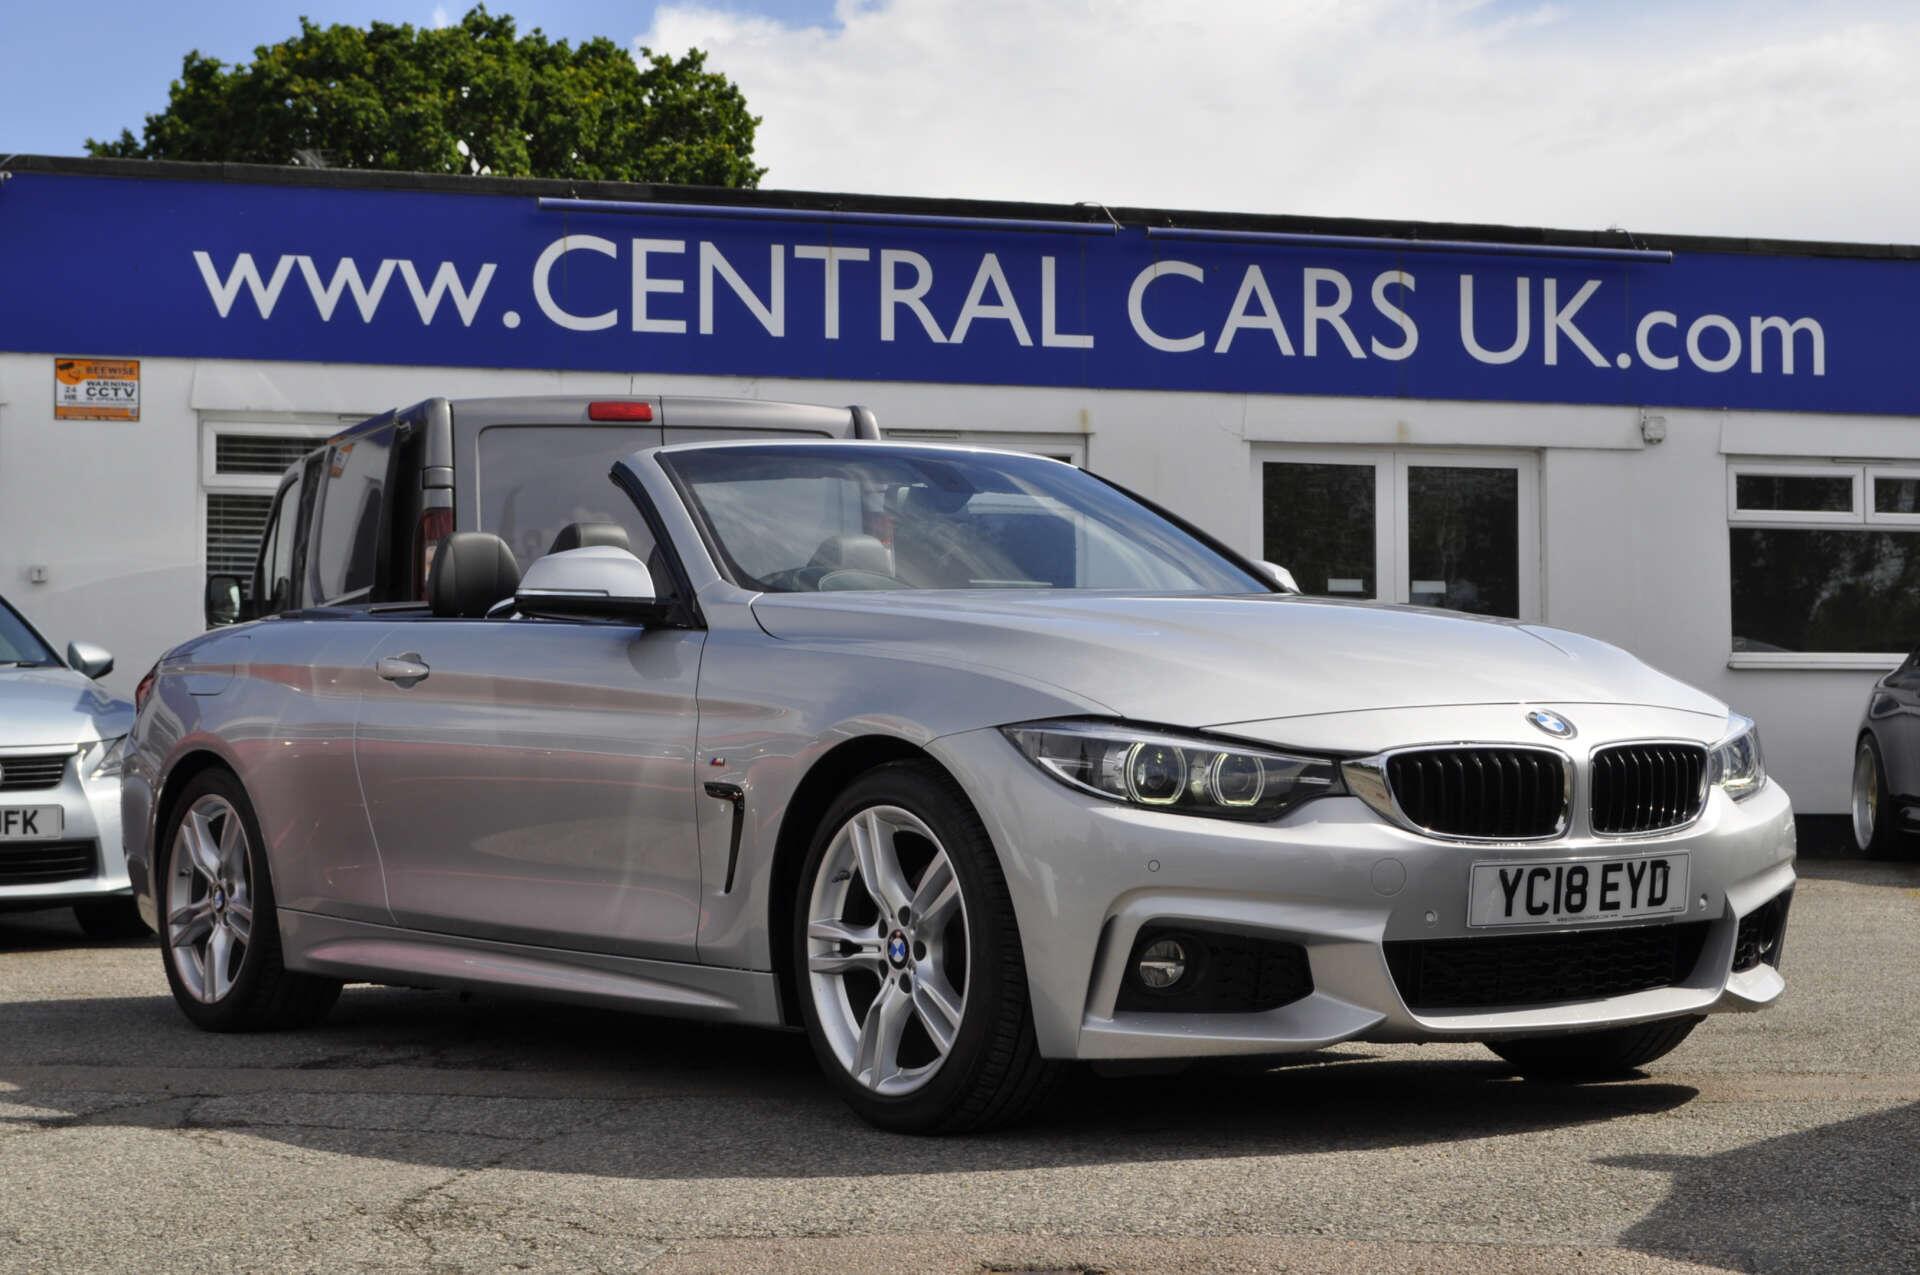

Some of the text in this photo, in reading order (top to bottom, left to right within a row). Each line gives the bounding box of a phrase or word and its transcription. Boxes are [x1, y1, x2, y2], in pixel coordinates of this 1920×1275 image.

[1127, 260, 1419, 361] CARS
[1460, 274, 1826, 376] UK.com
[86, 387, 135, 398] CCTV
[0, 809, 38, 835] FK
[1499, 859, 1671, 917] YC18 EYD
